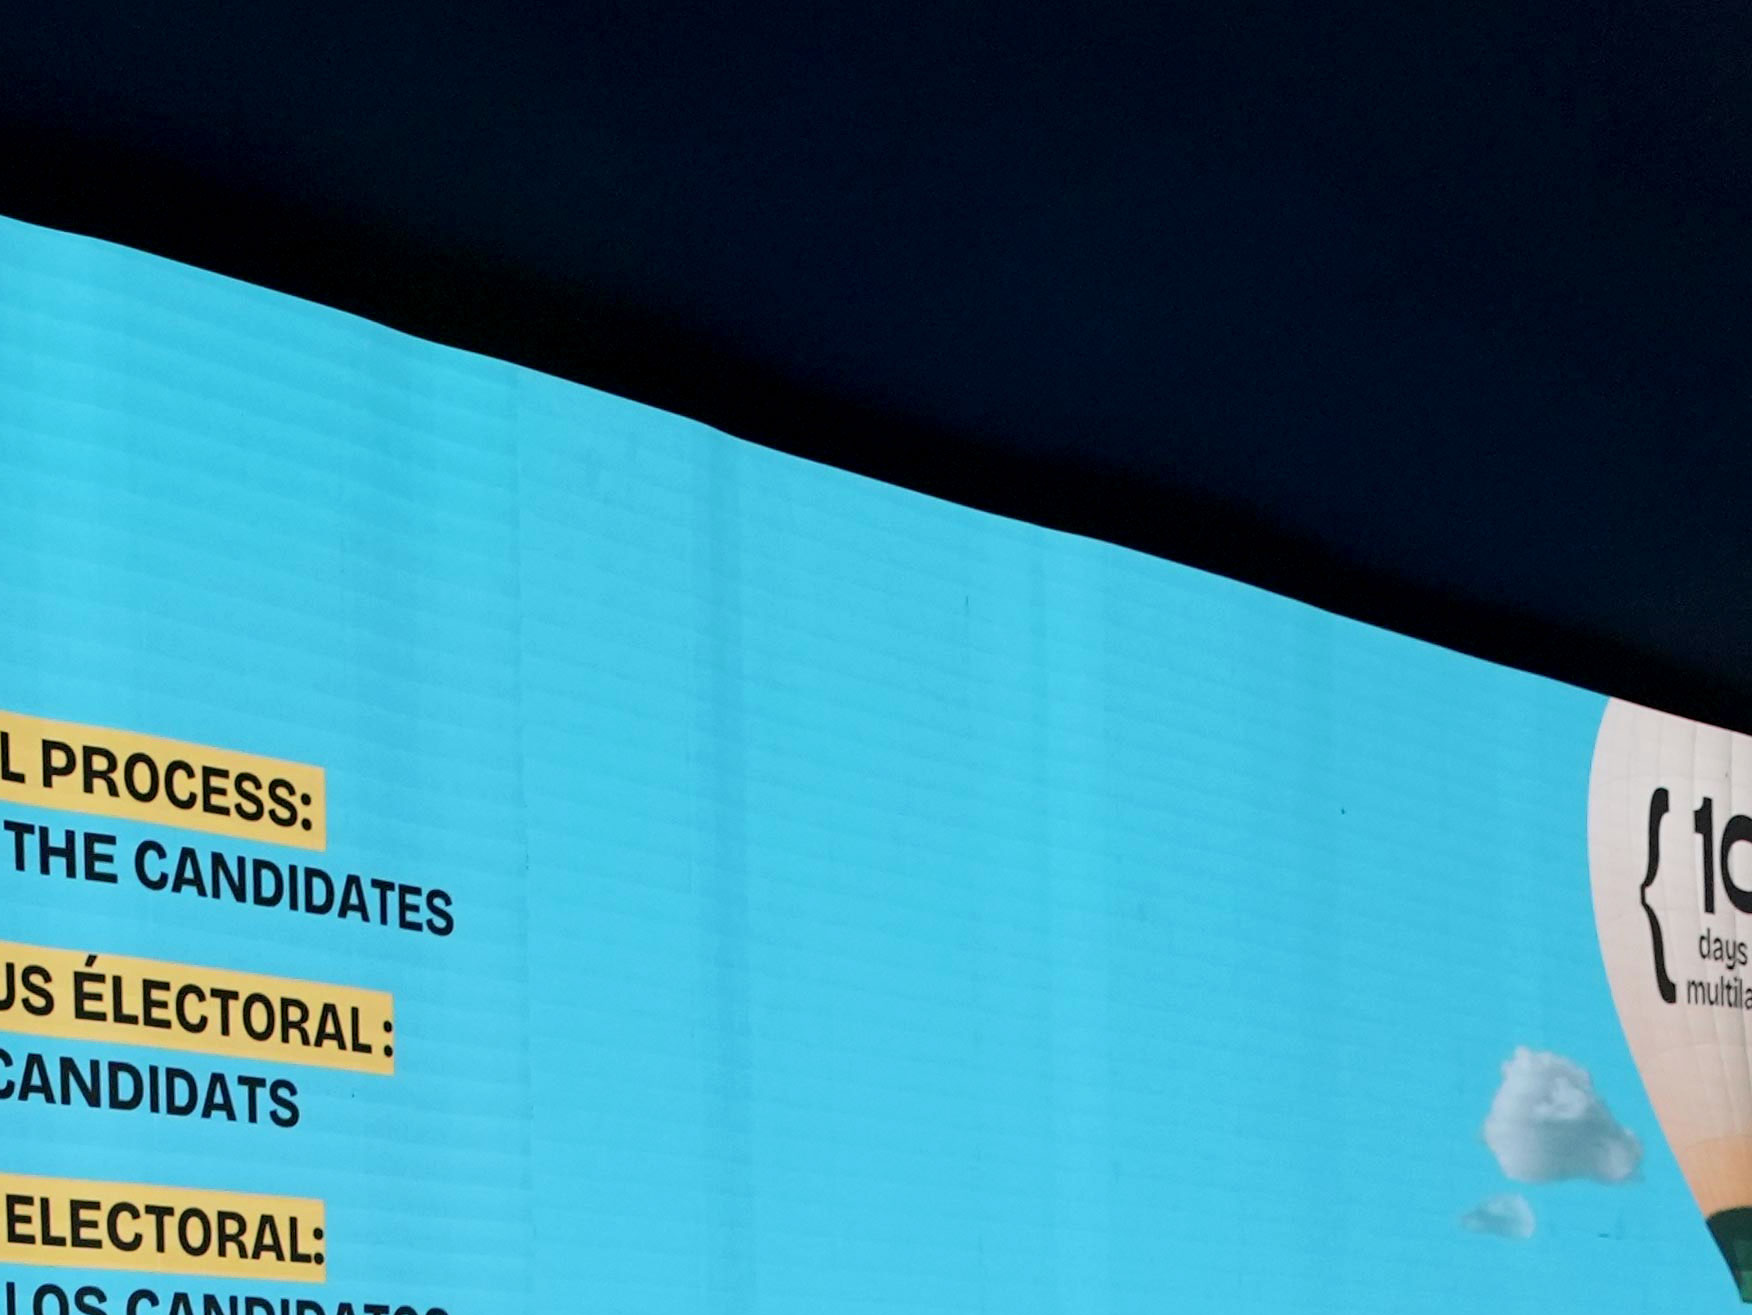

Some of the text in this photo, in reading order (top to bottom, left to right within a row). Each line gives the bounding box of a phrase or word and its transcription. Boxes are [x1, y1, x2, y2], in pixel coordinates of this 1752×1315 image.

[42, 739, 313, 831] PROCESS:
[4, 823, 118, 884] THE
[134, 840, 456, 936] CANDIDATES
[1699, 929, 1748, 973] days
[6, 1194, 325, 1265] ELECTORAL:
